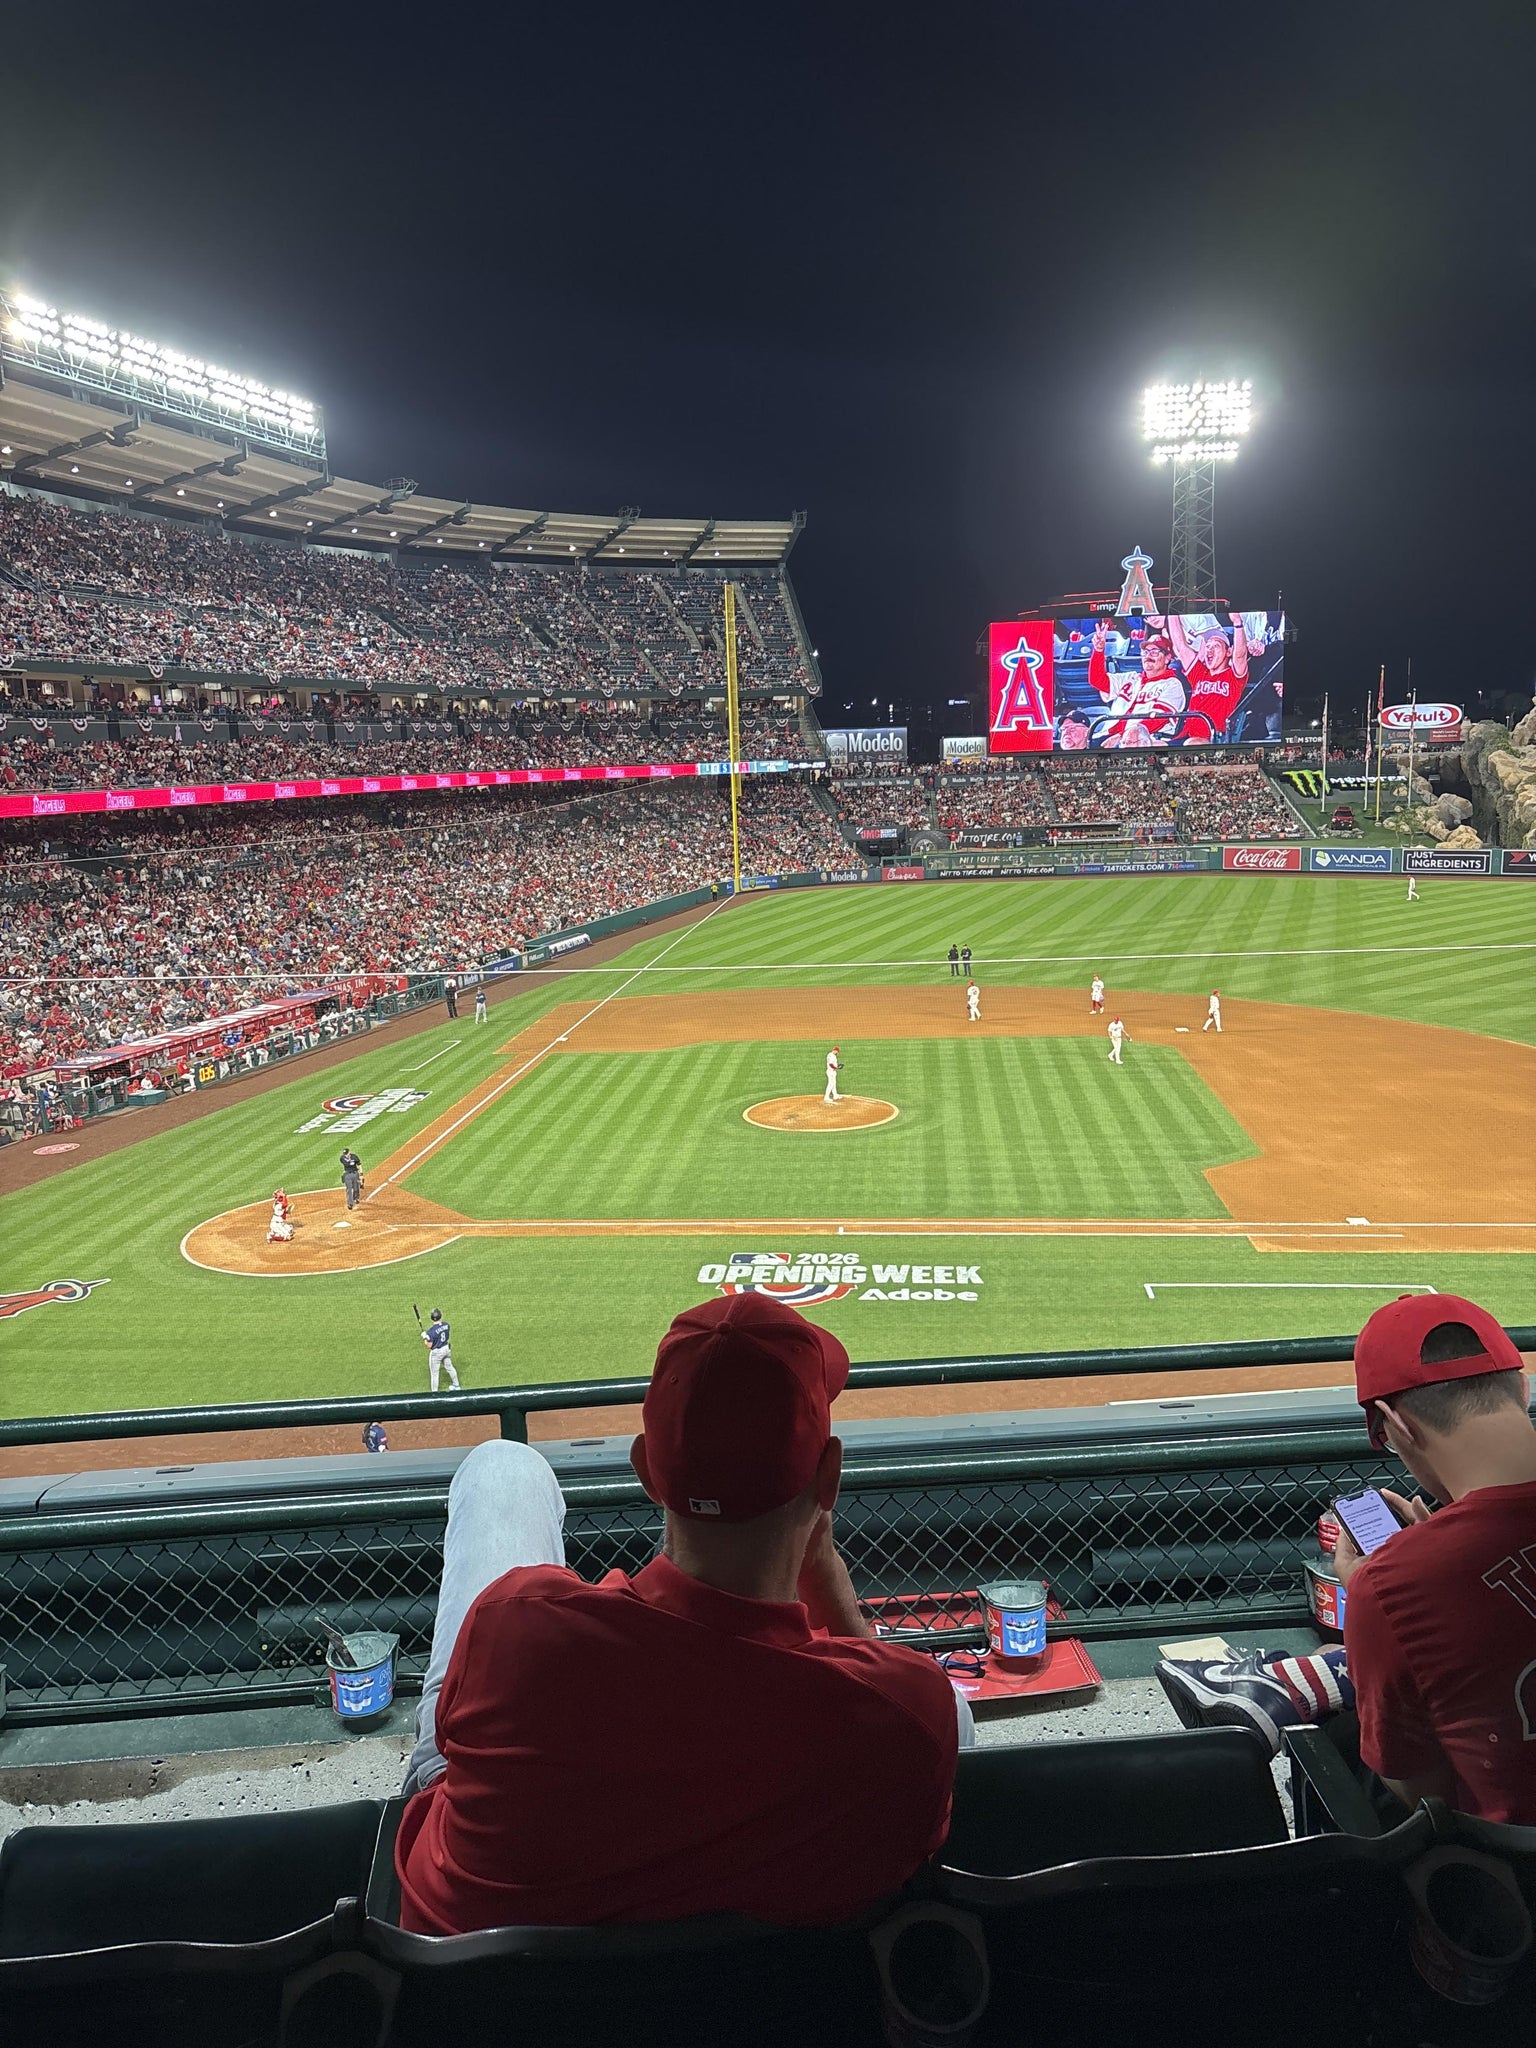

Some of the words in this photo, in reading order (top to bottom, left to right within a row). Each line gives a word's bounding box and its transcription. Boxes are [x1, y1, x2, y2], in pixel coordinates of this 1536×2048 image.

[1393, 710, 1448, 723] Yakult
[848, 732, 903, 753] Modelo
[949, 741, 982, 754] Modelo
[32, 794, 66, 814] ANGELS
[1233, 849, 1291, 868] Coca-Cola
[1331, 854, 1387, 865] VANDA
[1411, 851, 1434, 859] JUST
[1103, 863, 1165, 872] 714TICKETS.COM
[1411, 859, 1482, 869] INGREDIENTS
[830, 871, 858, 882] Modelo
[795, 1253, 859, 1265] 2026
[697, 1263, 868, 1284] OPENING
[871, 1264, 984, 1285] WEEK
[858, 1288, 978, 1301] Adobe
[440, 1331, 446, 1343] 8
